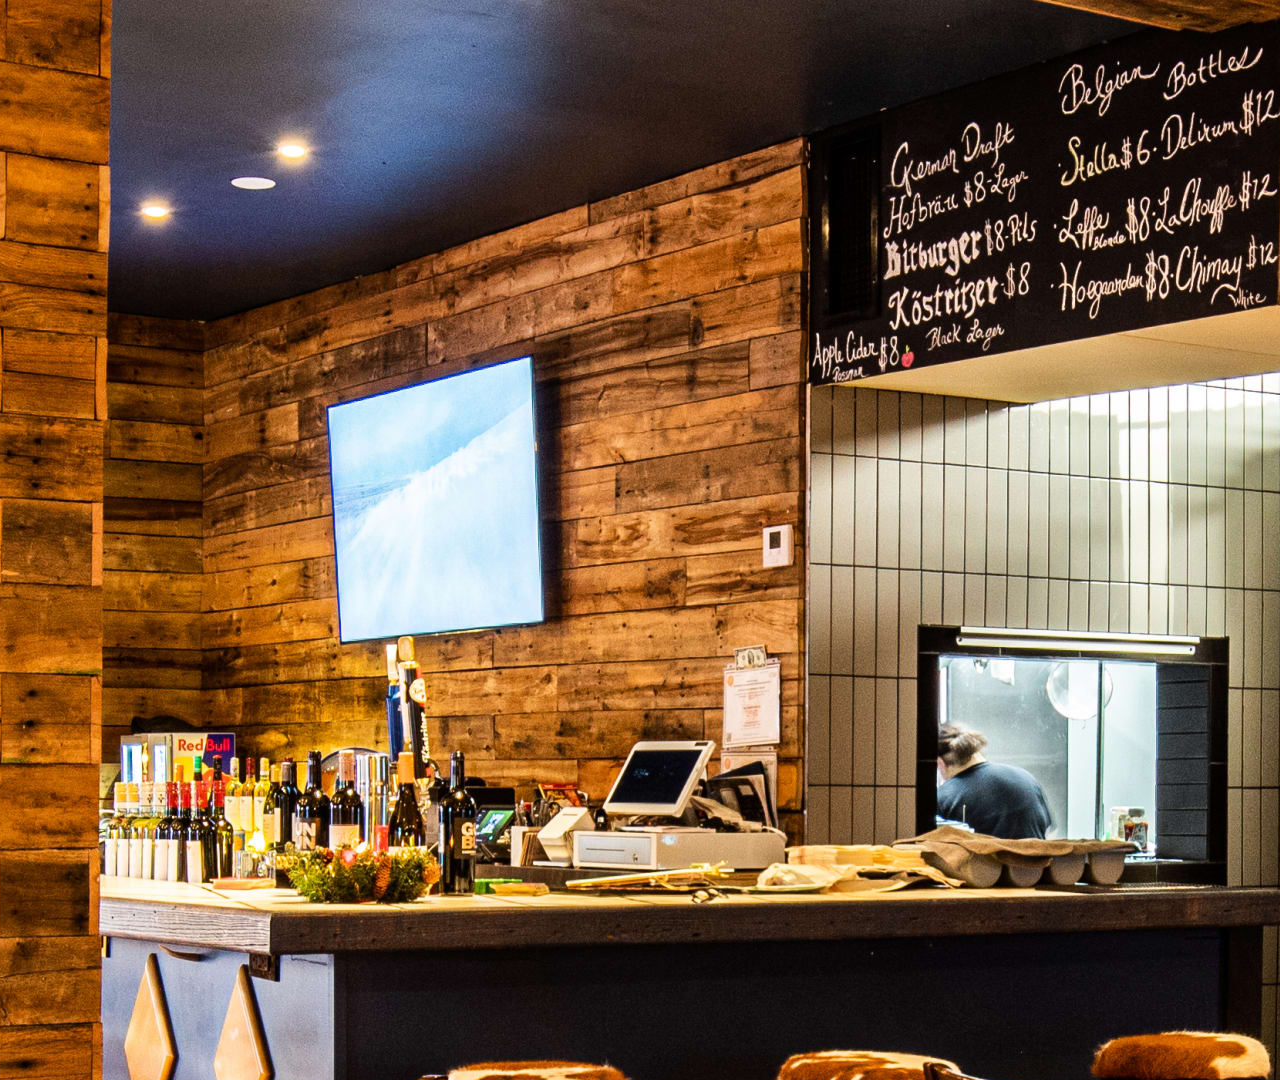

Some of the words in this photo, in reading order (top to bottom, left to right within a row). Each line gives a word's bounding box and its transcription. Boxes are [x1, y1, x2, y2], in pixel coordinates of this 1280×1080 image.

[1058, 61, 1160, 116] Belgian
[1163, 46, 1263, 100] Bottles
[891, 142, 959, 195] German
[961, 122, 1015, 168] Draft
[1060, 136, 1120, 186] Stella
[883, 193, 958, 239] Hofbräu
[1059, 198, 1109, 250] Leffe
[1238, 170, 1278, 212] $12
[883, 230, 982, 280] Bitburger
[1092, 230, 1126, 251] Blonde
[1058, 261, 1144, 319] Hoegaarden
[1175, 245, 1243, 304] Chimay
[1246, 234, 1279, 270] $12
[1228, 287, 1267, 309] White
[812, 332, 844, 379] Apple
[846, 330, 878, 363] Cider
[878, 335, 900, 372] $8
[925, 323, 961, 351] Black
[966, 318, 1005, 351] Lager
[178, 738, 203, 751] Red
[206, 738, 231, 752] Bull
